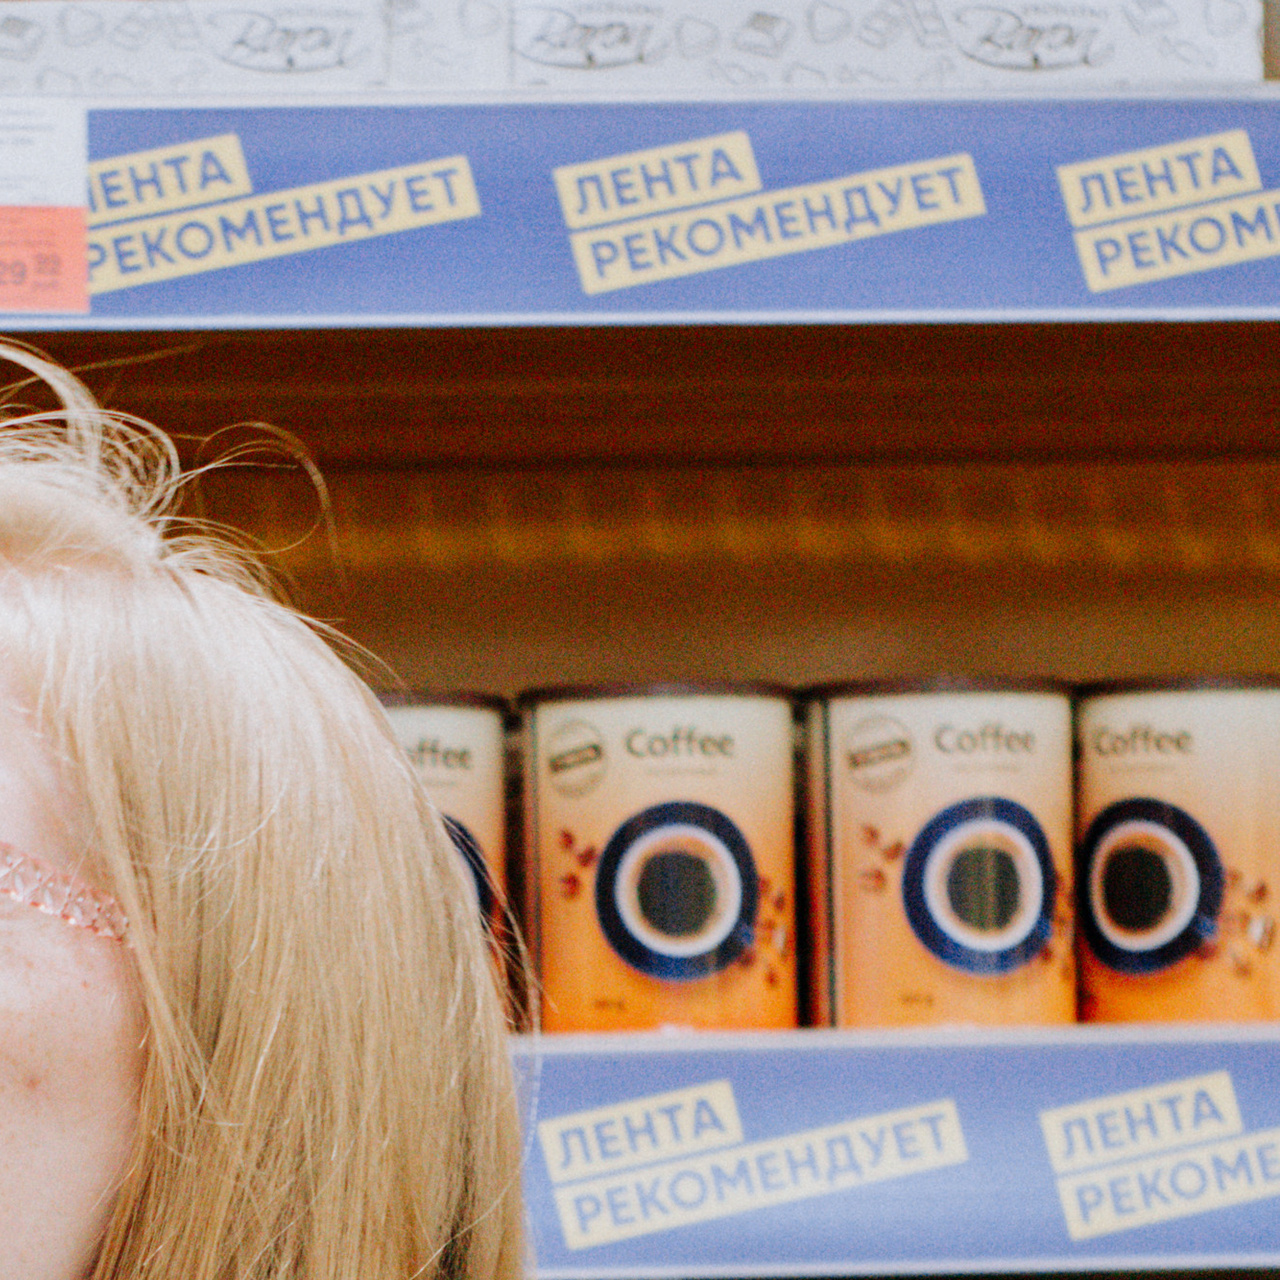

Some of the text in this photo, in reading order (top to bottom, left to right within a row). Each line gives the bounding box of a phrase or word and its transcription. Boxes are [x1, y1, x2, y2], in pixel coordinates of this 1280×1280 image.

[87, 149, 233, 214] ЕНТА
[575, 147, 744, 214] ЛЕНТА
[1079, 145, 1244, 212] ЛЕНТА
[590, 165, 965, 279] РЕКОМЕНДУЕТ
[1095, 201, 1280, 278] РЕКОМ
[625, 727, 735, 758] Coffee
[934, 723, 1037, 755] Coffee
[1091, 726, 1193, 757] Coffee
[558, 1097, 728, 1168] ЛЕНТА
[1062, 1089, 1226, 1159] ЛЕНТА
[574, 1112, 949, 1234] РЕКОМЕНДУЕТ
